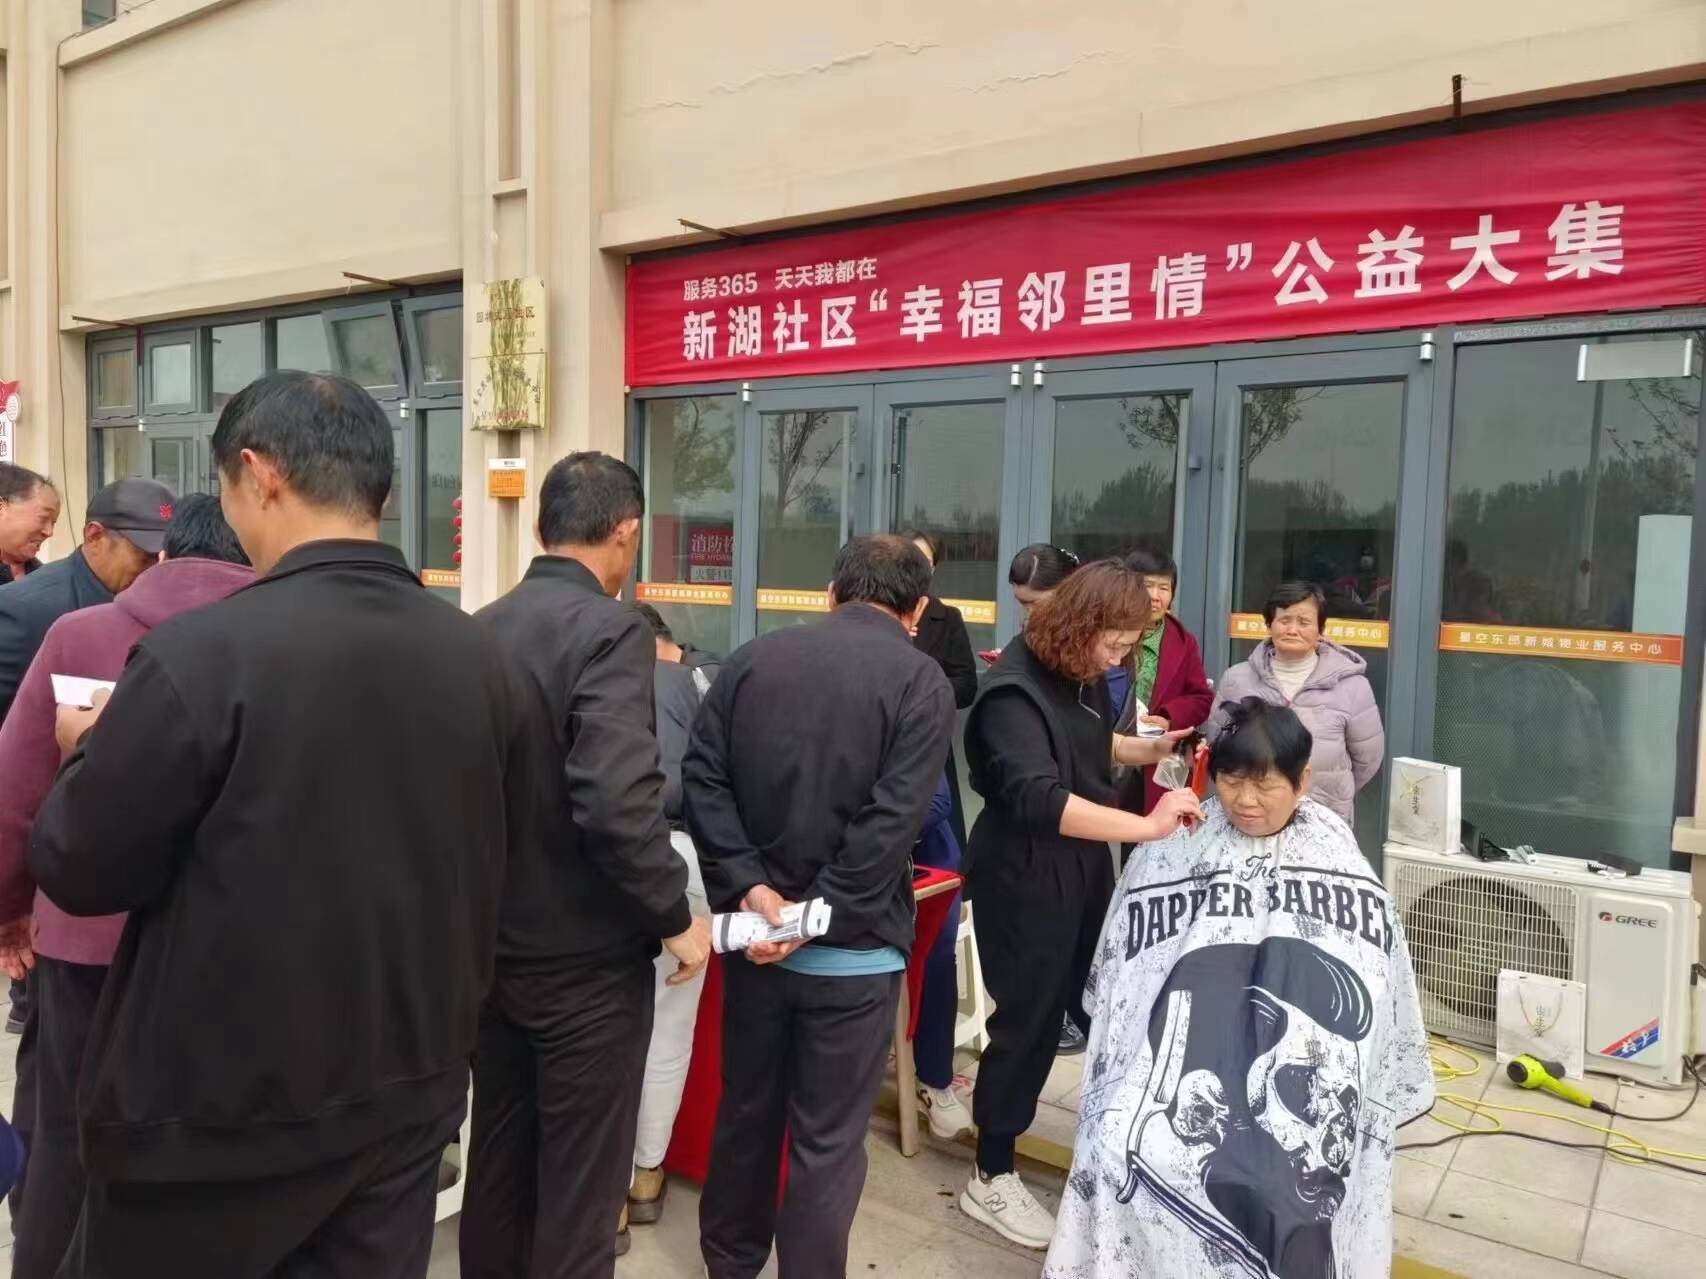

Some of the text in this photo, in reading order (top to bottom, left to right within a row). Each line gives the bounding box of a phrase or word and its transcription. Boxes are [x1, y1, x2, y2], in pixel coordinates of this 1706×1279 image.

[683, 257, 878, 301] 服务365 天天我都在
[683, 200, 1625, 361] 新湖社区“幸福邻里情”公益大集
[1239, 852, 1277, 881] The
[1125, 882, 1254, 962] DAPPER
[1615, 914, 1657, 929] GREE
